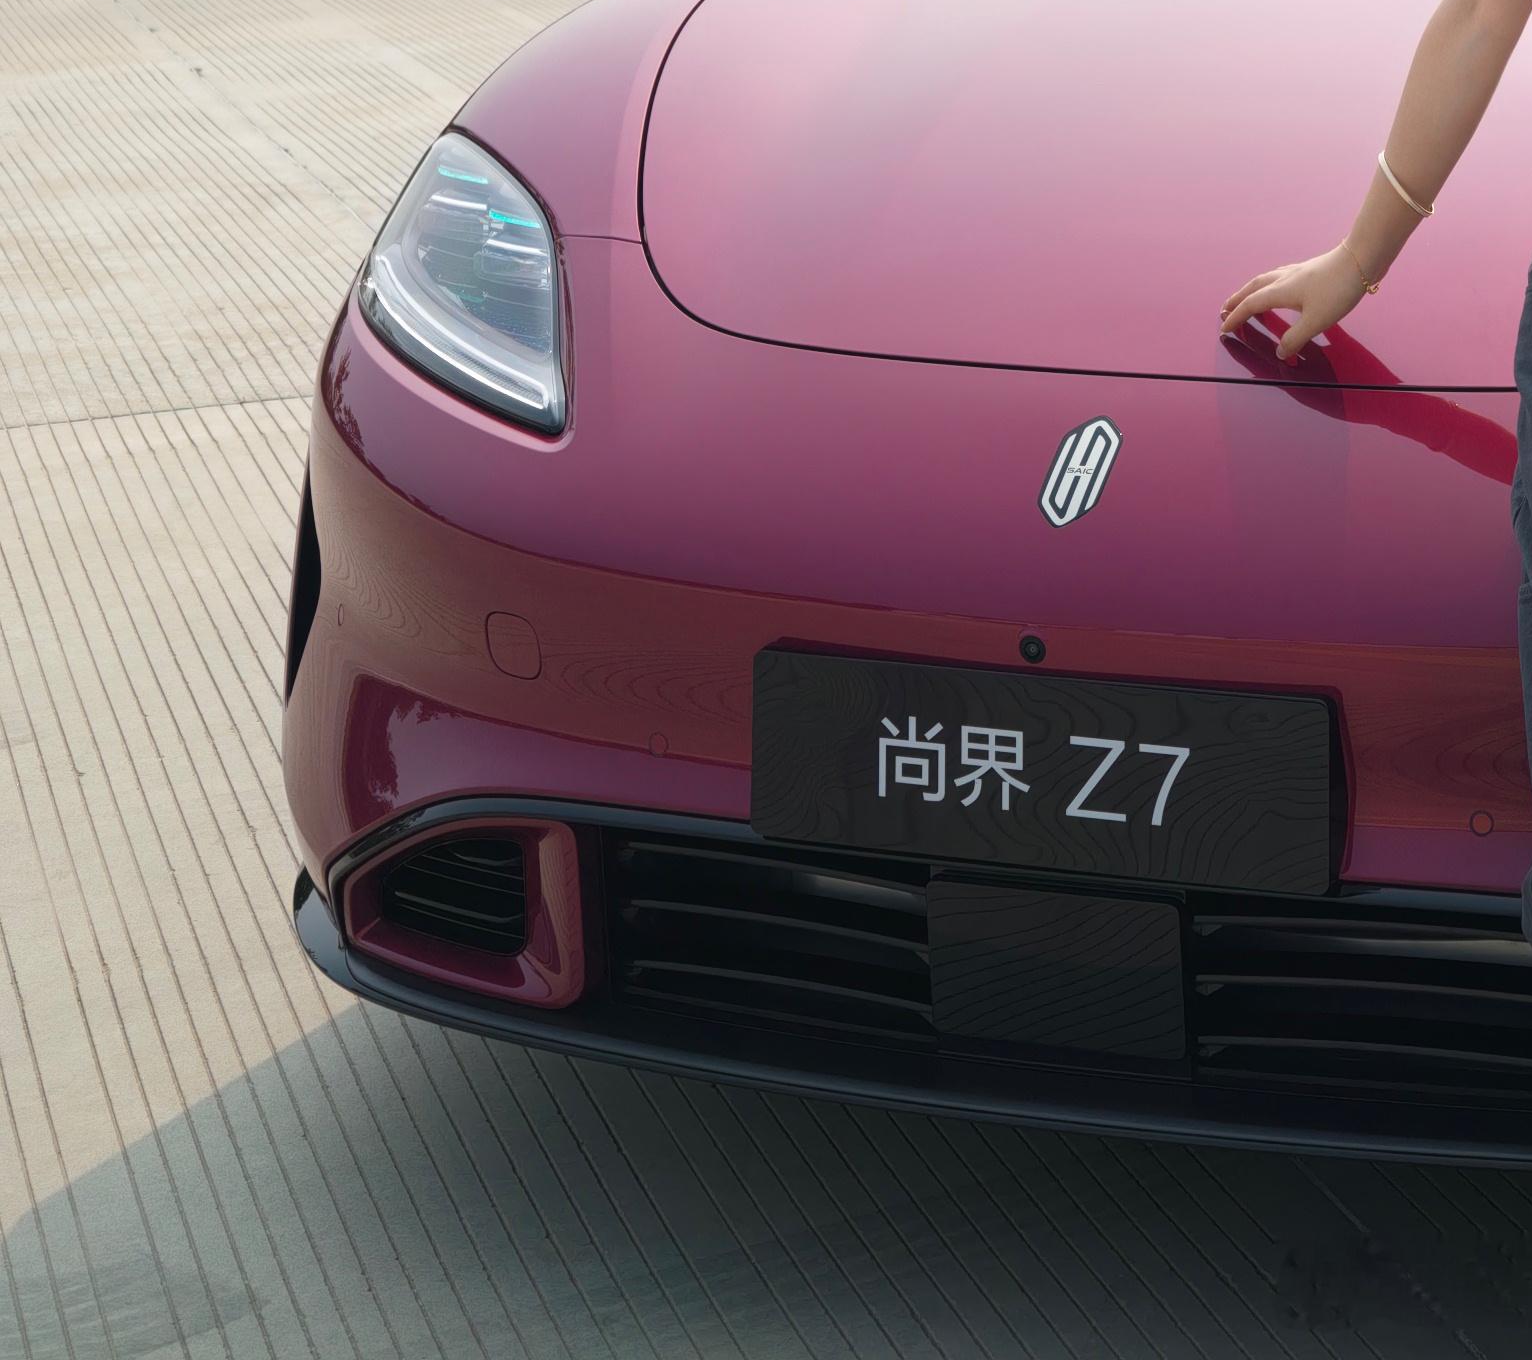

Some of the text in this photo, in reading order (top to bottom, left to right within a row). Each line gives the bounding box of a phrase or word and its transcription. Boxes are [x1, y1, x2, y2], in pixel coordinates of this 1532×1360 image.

[1066, 467, 1094, 475] SAIC
[878, 715, 1191, 826] 尚界 Z7
